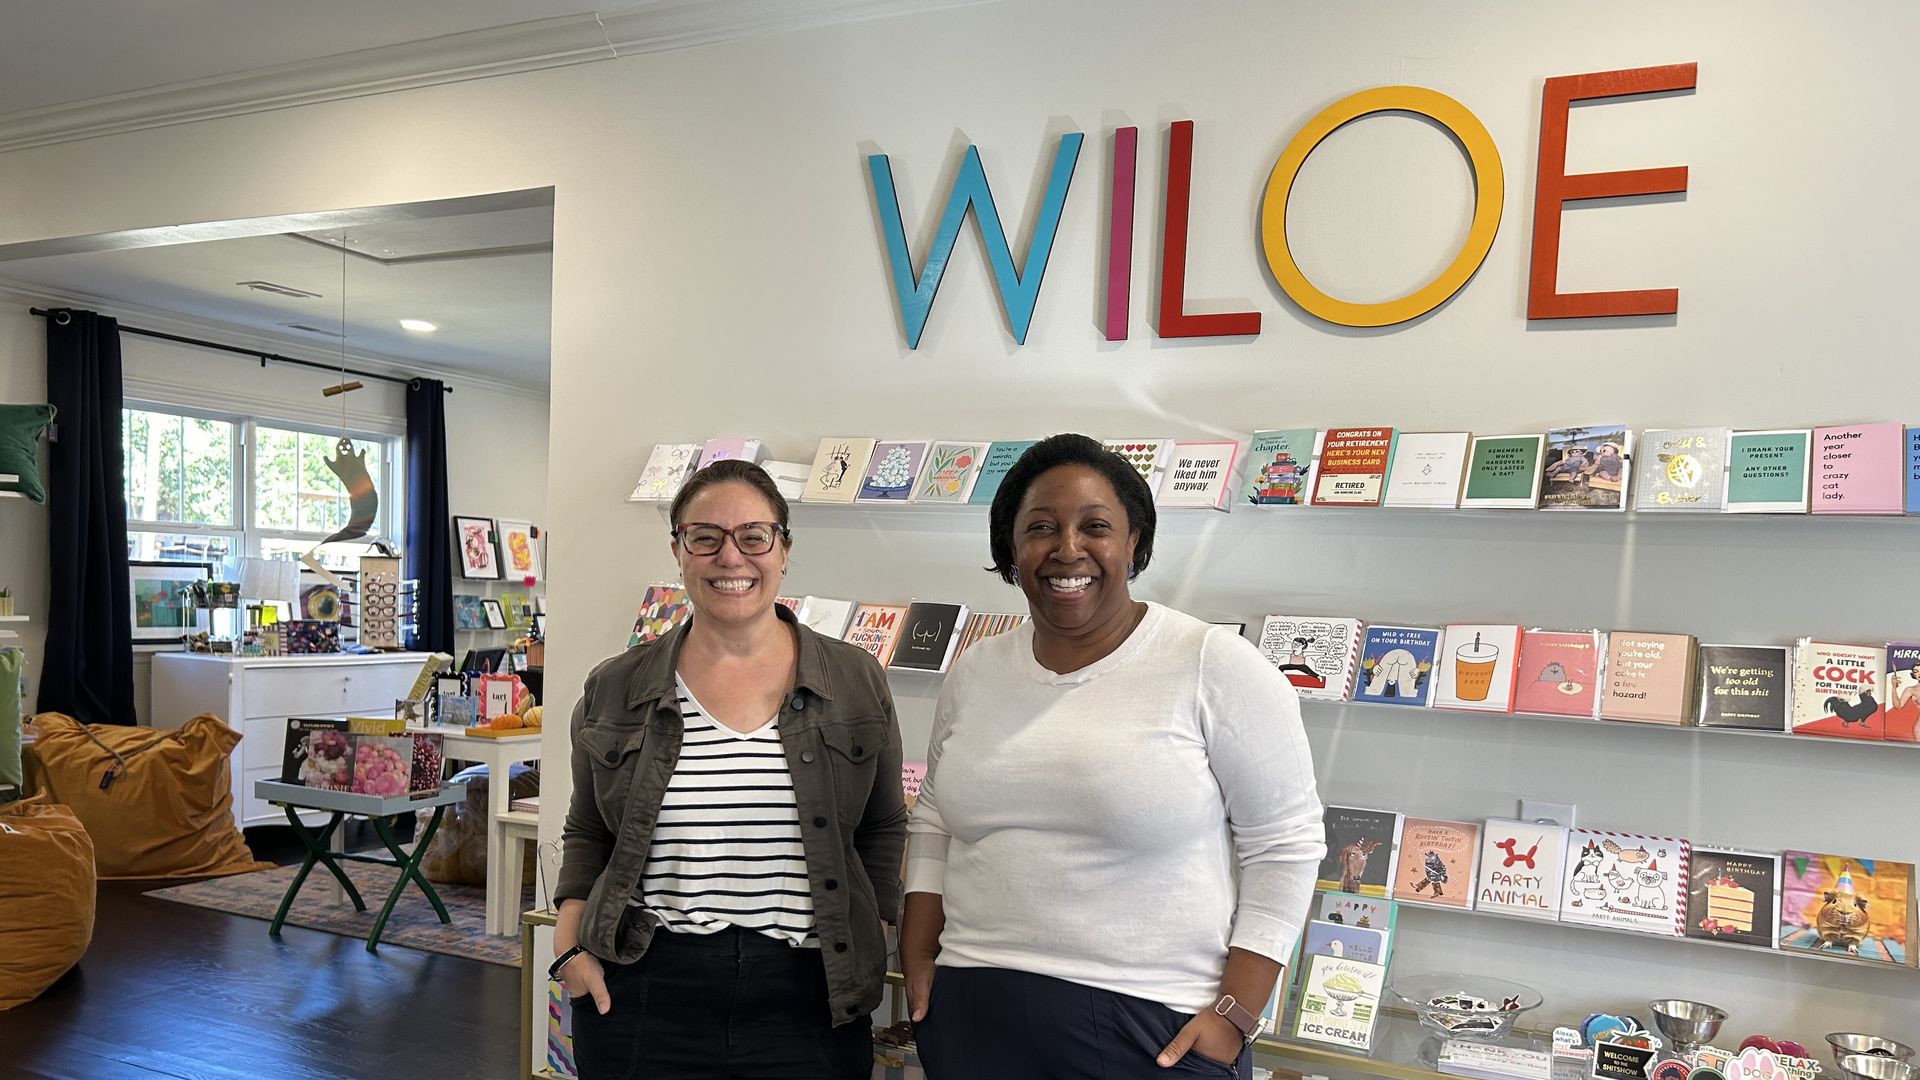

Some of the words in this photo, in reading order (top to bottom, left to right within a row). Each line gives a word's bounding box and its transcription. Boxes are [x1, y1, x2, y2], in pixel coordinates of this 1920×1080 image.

[868, 61, 1698, 350] WILOE
[1824, 432, 1863, 441] Another
[1255, 444, 1290, 452] chapter.
[1824, 443, 1845, 451] year
[1824, 452, 1852, 460] closer
[1178, 458, 1192, 468] We
[1194, 459, 1220, 468] never
[1174, 470, 1197, 480] liked
[1199, 470, 1217, 479] him
[1823, 472, 1849, 480] crazy
[1174, 481, 1208, 491] anyway.
[1823, 492, 1845, 500] lady.
[855, 612, 865, 626] I
[863, 612, 896, 630] AM
[851, 633, 887, 642] FUCKING
[1637, 641, 1665, 650] saying
[1711, 666, 1737, 675] We're
[1740, 668, 1773, 677] getting
[1813, 666, 1875, 684] COCK
[1613, 690, 1646, 699] hazard!
[1714, 688, 1729, 696] for
[1731, 688, 1749, 696] this
[350, 720, 385, 733] Vivid
[1727, 867, 1766, 876] BIRTHDAY
[1491, 872, 1543, 889] PARTY
[1481, 888, 1549, 908] ANIMAL
[1336, 902, 1376, 914] HAPPY
[1348, 943, 1373, 952] HELLO
[1321, 965, 1333, 975] you
[1336, 962, 1361, 975] deserve
[1303, 1023, 1322, 1035] ICE
[1325, 1027, 1366, 1042] CREAM
[1604, 1051, 1639, 1063] WELCOME
[1602, 1064, 1638, 1075] SHITSHOW
[1744, 1067, 1772, 1079] DOG
